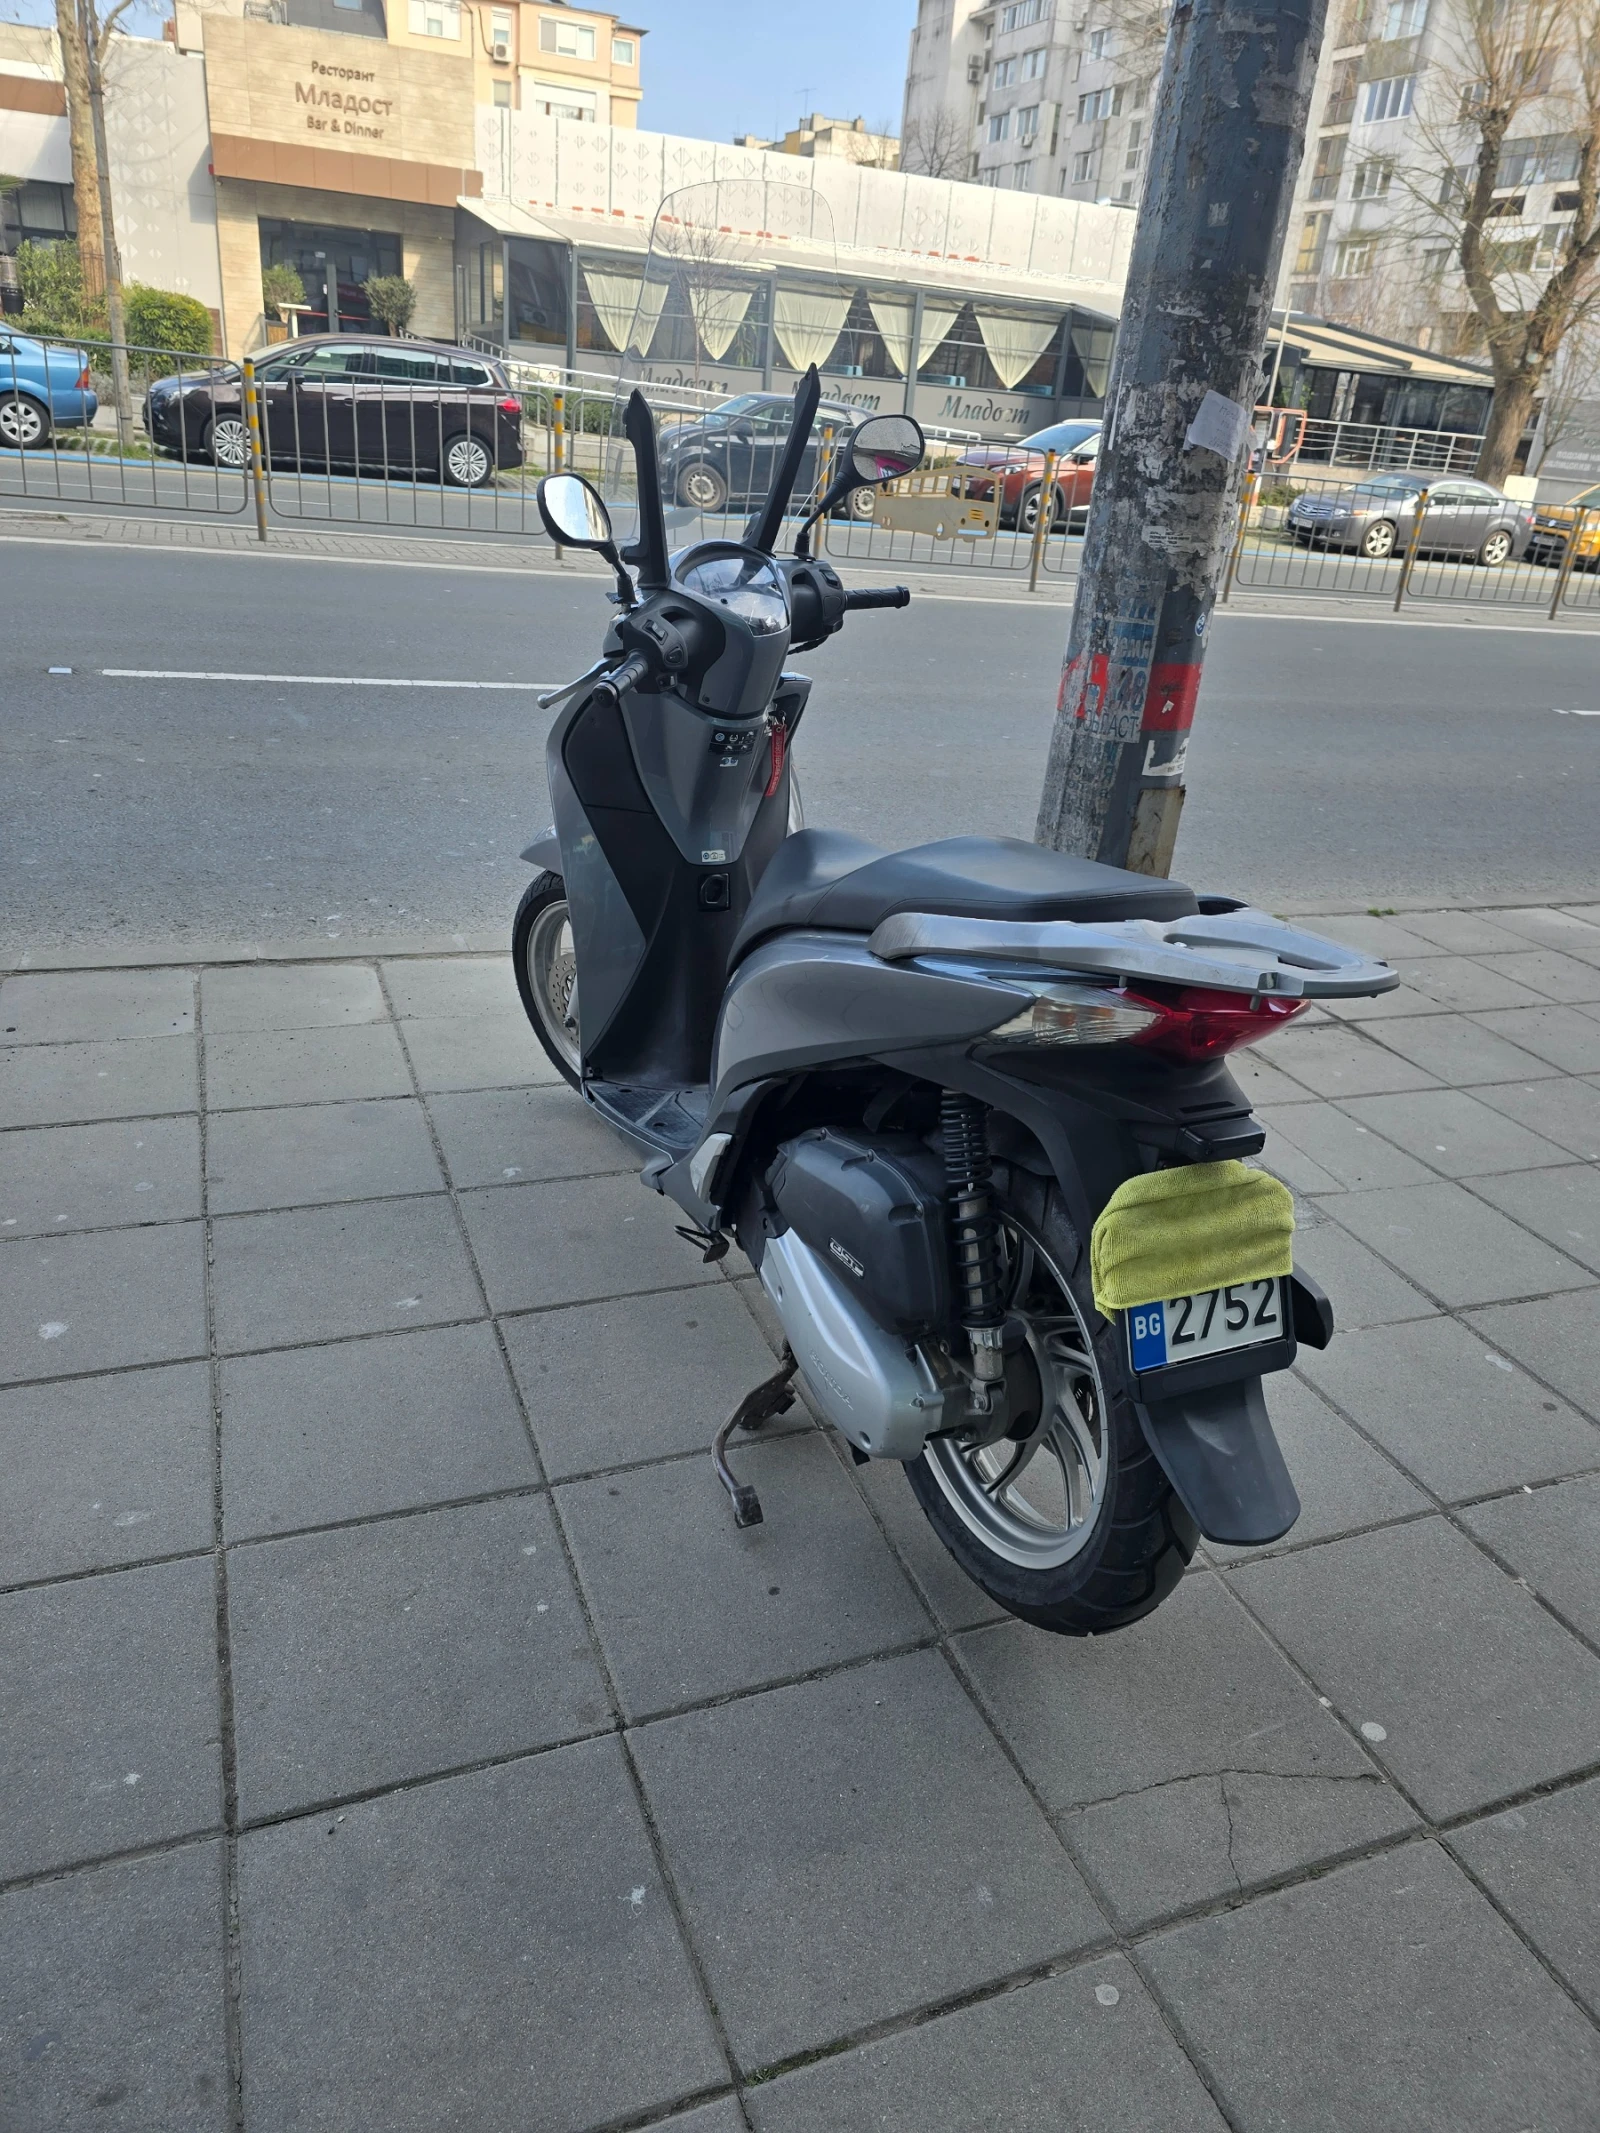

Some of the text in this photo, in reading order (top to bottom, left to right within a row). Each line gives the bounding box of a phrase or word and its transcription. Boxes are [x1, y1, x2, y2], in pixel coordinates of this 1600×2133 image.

[311, 60, 375, 82] Ресторант
[295, 81, 393, 116] Младост
[307, 114, 385, 139] Bar & Dinner
[1134, 1278, 1277, 1346] BG 2752
